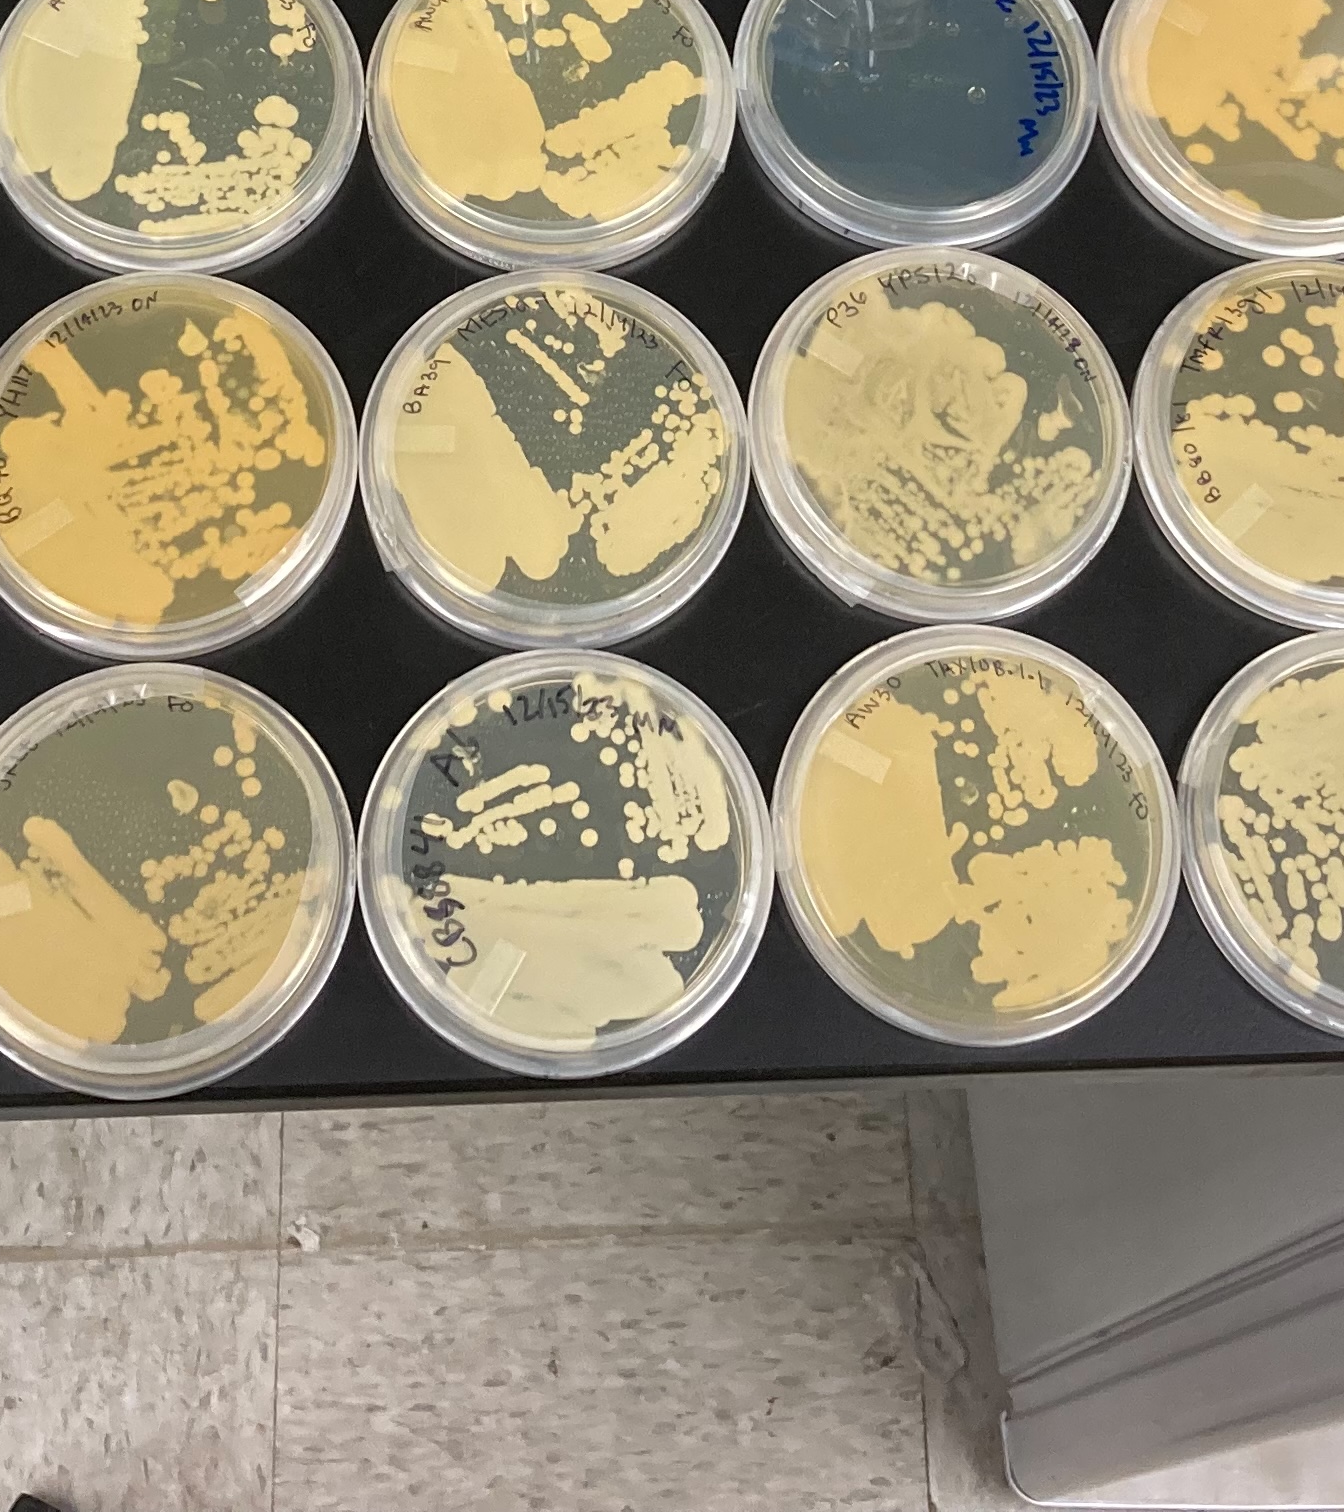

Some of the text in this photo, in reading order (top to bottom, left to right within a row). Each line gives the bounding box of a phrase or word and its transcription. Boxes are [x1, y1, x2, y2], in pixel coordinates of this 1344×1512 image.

[1013, 17, 1066, 118] 12/15/23
[42, 299, 125, 351] 12/14/23
[129, 291, 157, 312] ON
[822, 288, 872, 330] P36
[403, 349, 451, 415] BA39
[843, 673, 905, 730] AW30
